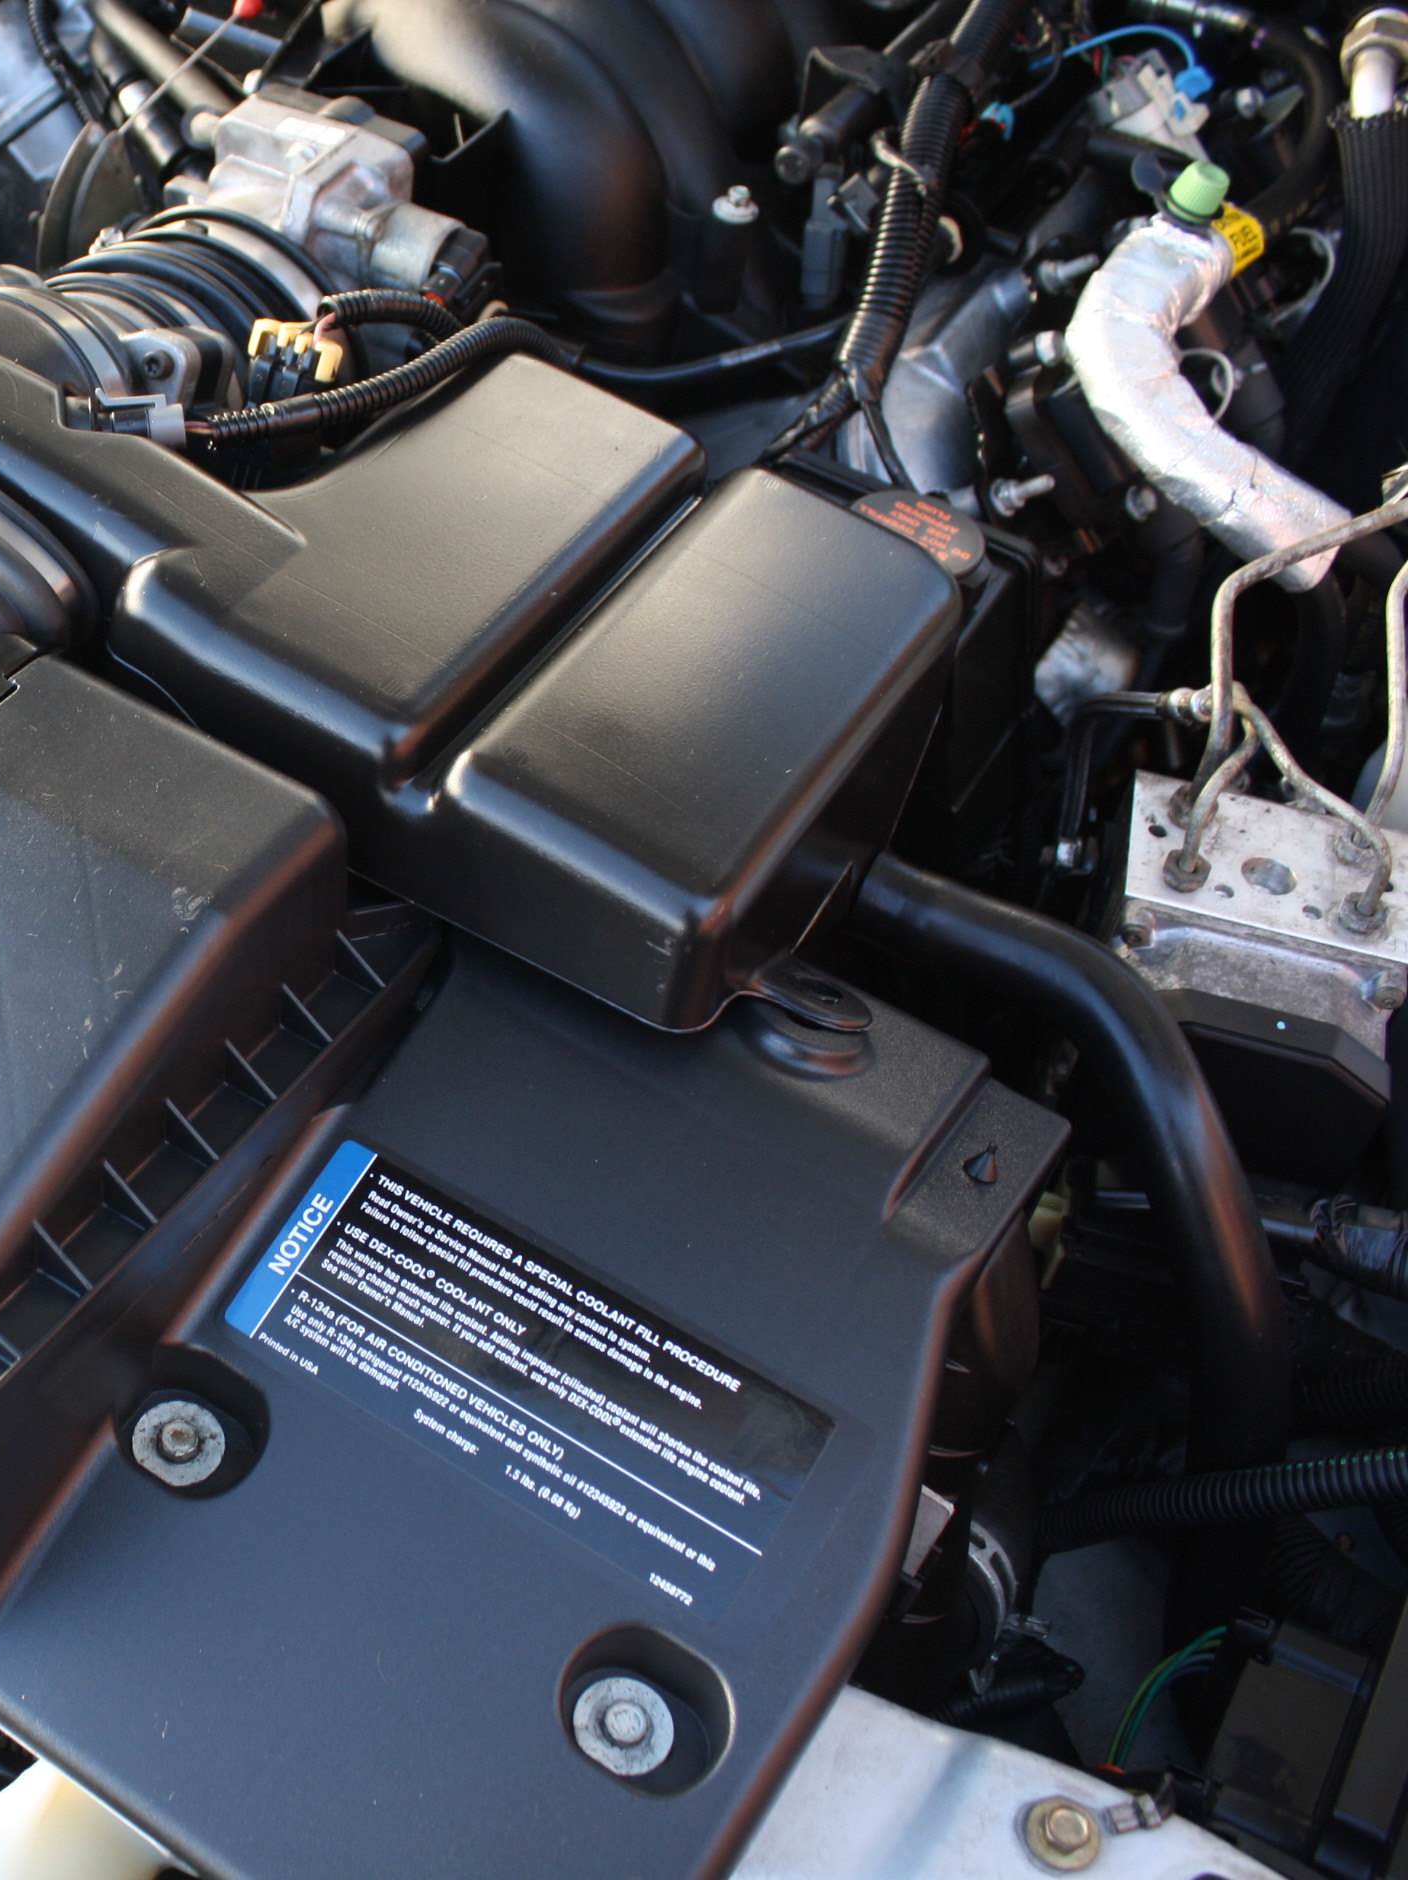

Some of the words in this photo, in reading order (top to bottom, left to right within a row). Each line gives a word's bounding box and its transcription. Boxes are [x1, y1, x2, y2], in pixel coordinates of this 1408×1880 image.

[1229, 226, 1258, 249] FUEL
[895, 501, 960, 534] APPROVED
[916, 501, 952, 521] FLUID
[920, 536, 948, 549] NOT
[268, 1193, 334, 1276] NOTICE
[320, 1258, 338, 1274] See
[336, 1269, 357, 1285] your
[357, 1280, 391, 1306] Owner's
[391, 1300, 424, 1328] Manual.
[344, 1222, 369, 1243] USE
[435, 1277, 494, 1316] COOLANT
[493, 1311, 526, 1335] ONLY
[360, 1201, 390, 1224] Failure
[389, 1218, 399, 1230] to
[399, 1224, 426, 1245] follow
[425, 1241, 458, 1264] special
[456, 1258, 471, 1271] fill
[468, 1267, 513, 1297] procedure
[512, 1292, 539, 1311] could
[537, 1307, 564, 1327] result
[563, 1320, 574, 1332] in
[573, 1328, 607, 1352] serious
[606, 1347, 643, 1373] damage
[642, 1366, 653, 1379] to
[653, 1373, 669, 1388] the
[669, 1384, 702, 1409] engine.
[367, 1190, 391, 1209] Read
[390, 1203, 424, 1228] Owner's
[423, 1224, 435, 1234] or
[434, 1229, 466, 1253] Service
[466, 1247, 500, 1272] Manual
[498, 1266, 527, 1289] before
[526, 1284, 557, 1308] adding
[557, 1302, 575, 1317] any
[574, 1312, 608, 1336] coolant
[607, 1330, 618, 1342] to
[617, 1337, 650, 1362] system.
[378, 1174, 404, 1196] THIS
[404, 1189, 453, 1225] VEHICLE
[452, 1218, 512, 1259] REQUIRES
[512, 1254, 522, 1266] A
[523, 1260, 572, 1296] SPECIAL
[575, 1290, 636, 1329] COOLANT
[634, 1324, 659, 1347] FILL
[662, 1340, 741, 1392] PROCEDURE
[258, 1332, 290, 1356] Printed
[288, 1351, 298, 1362] in
[299, 1357, 318, 1375] USA
[283, 1314, 300, 1328] A/C
[299, 1324, 329, 1347] system
[329, 1342, 347, 1358] will
[346, 1352, 358, 1365] be
[358, 1360, 398, 1391] damaged.
[297, 1290, 335, 1319] R-134a
[334, 1314, 365, 1337] (FOR
[364, 1332, 387, 1351] AIR
[387, 1345, 468, 1399] CONDITIONED
[468, 1393, 526, 1436] VEHICLES
[527, 1430, 564, 1460] ONLY)
[327, 1249, 365, 1278] requiring
[365, 1272, 396, 1295] change
[396, 1290, 420, 1309] much
[419, 1304, 450, 1328] sooner.
[452, 1322, 462, 1333] If
[459, 1328, 477, 1343] you
[476, 1339, 495, 1354] add
[494, 1349, 528, 1376] coolant,
[530, 1370, 547, 1385] use
[547, 1381, 568, 1399] only
[618, 1424, 661, 1453] extended
[660, 1446, 676, 1463] life
[676, 1458, 709, 1482] engine
[708, 1477, 744, 1505] coolant.
[335, 1237, 354, 1254] This
[353, 1250, 384, 1273] vehicle
[383, 1267, 400, 1282] has
[400, 1278, 440, 1306] extended
[438, 1299, 454, 1315] life
[454, 1310, 487, 1336] coolant.
[489, 1330, 520, 1356] Adding
[520, 1348, 561, 1378] improper
[559, 1372, 606, 1407] (silicated)
[605, 1400, 640, 1426] coolant
[639, 1420, 658, 1436] will
[656, 1431, 692, 1457] shorten
[691, 1450, 708, 1466] the
[708, 1461, 743, 1487] coolant
[290, 1304, 307, 1320] Use
[307, 1316, 326, 1333] only
[325, 1326, 356, 1351] R-134a
[356, 1346, 402, 1379] refrigerant
[448, 1403, 460, 1414] or
[459, 1409, 505, 1442] equivalent
[504, 1437, 523, 1453] and
[522, 1448, 562, 1478] synthetic
[562, 1473, 577, 1486] oil
[625, 1511, 637, 1523] or
[636, 1518, 686, 1553] equivalent
[684, 1547, 697, 1559] or
[696, 1553, 715, 1571] this
[413, 1408, 445, 1434] System
[445, 1430, 479, 1455] charge:
[504, 1464, 521, 1480] 1.5
[519, 1473, 535, 1492] lbs.
[537, 1485, 564, 1507] (0.68
[563, 1500, 580, 1519] Kg)
